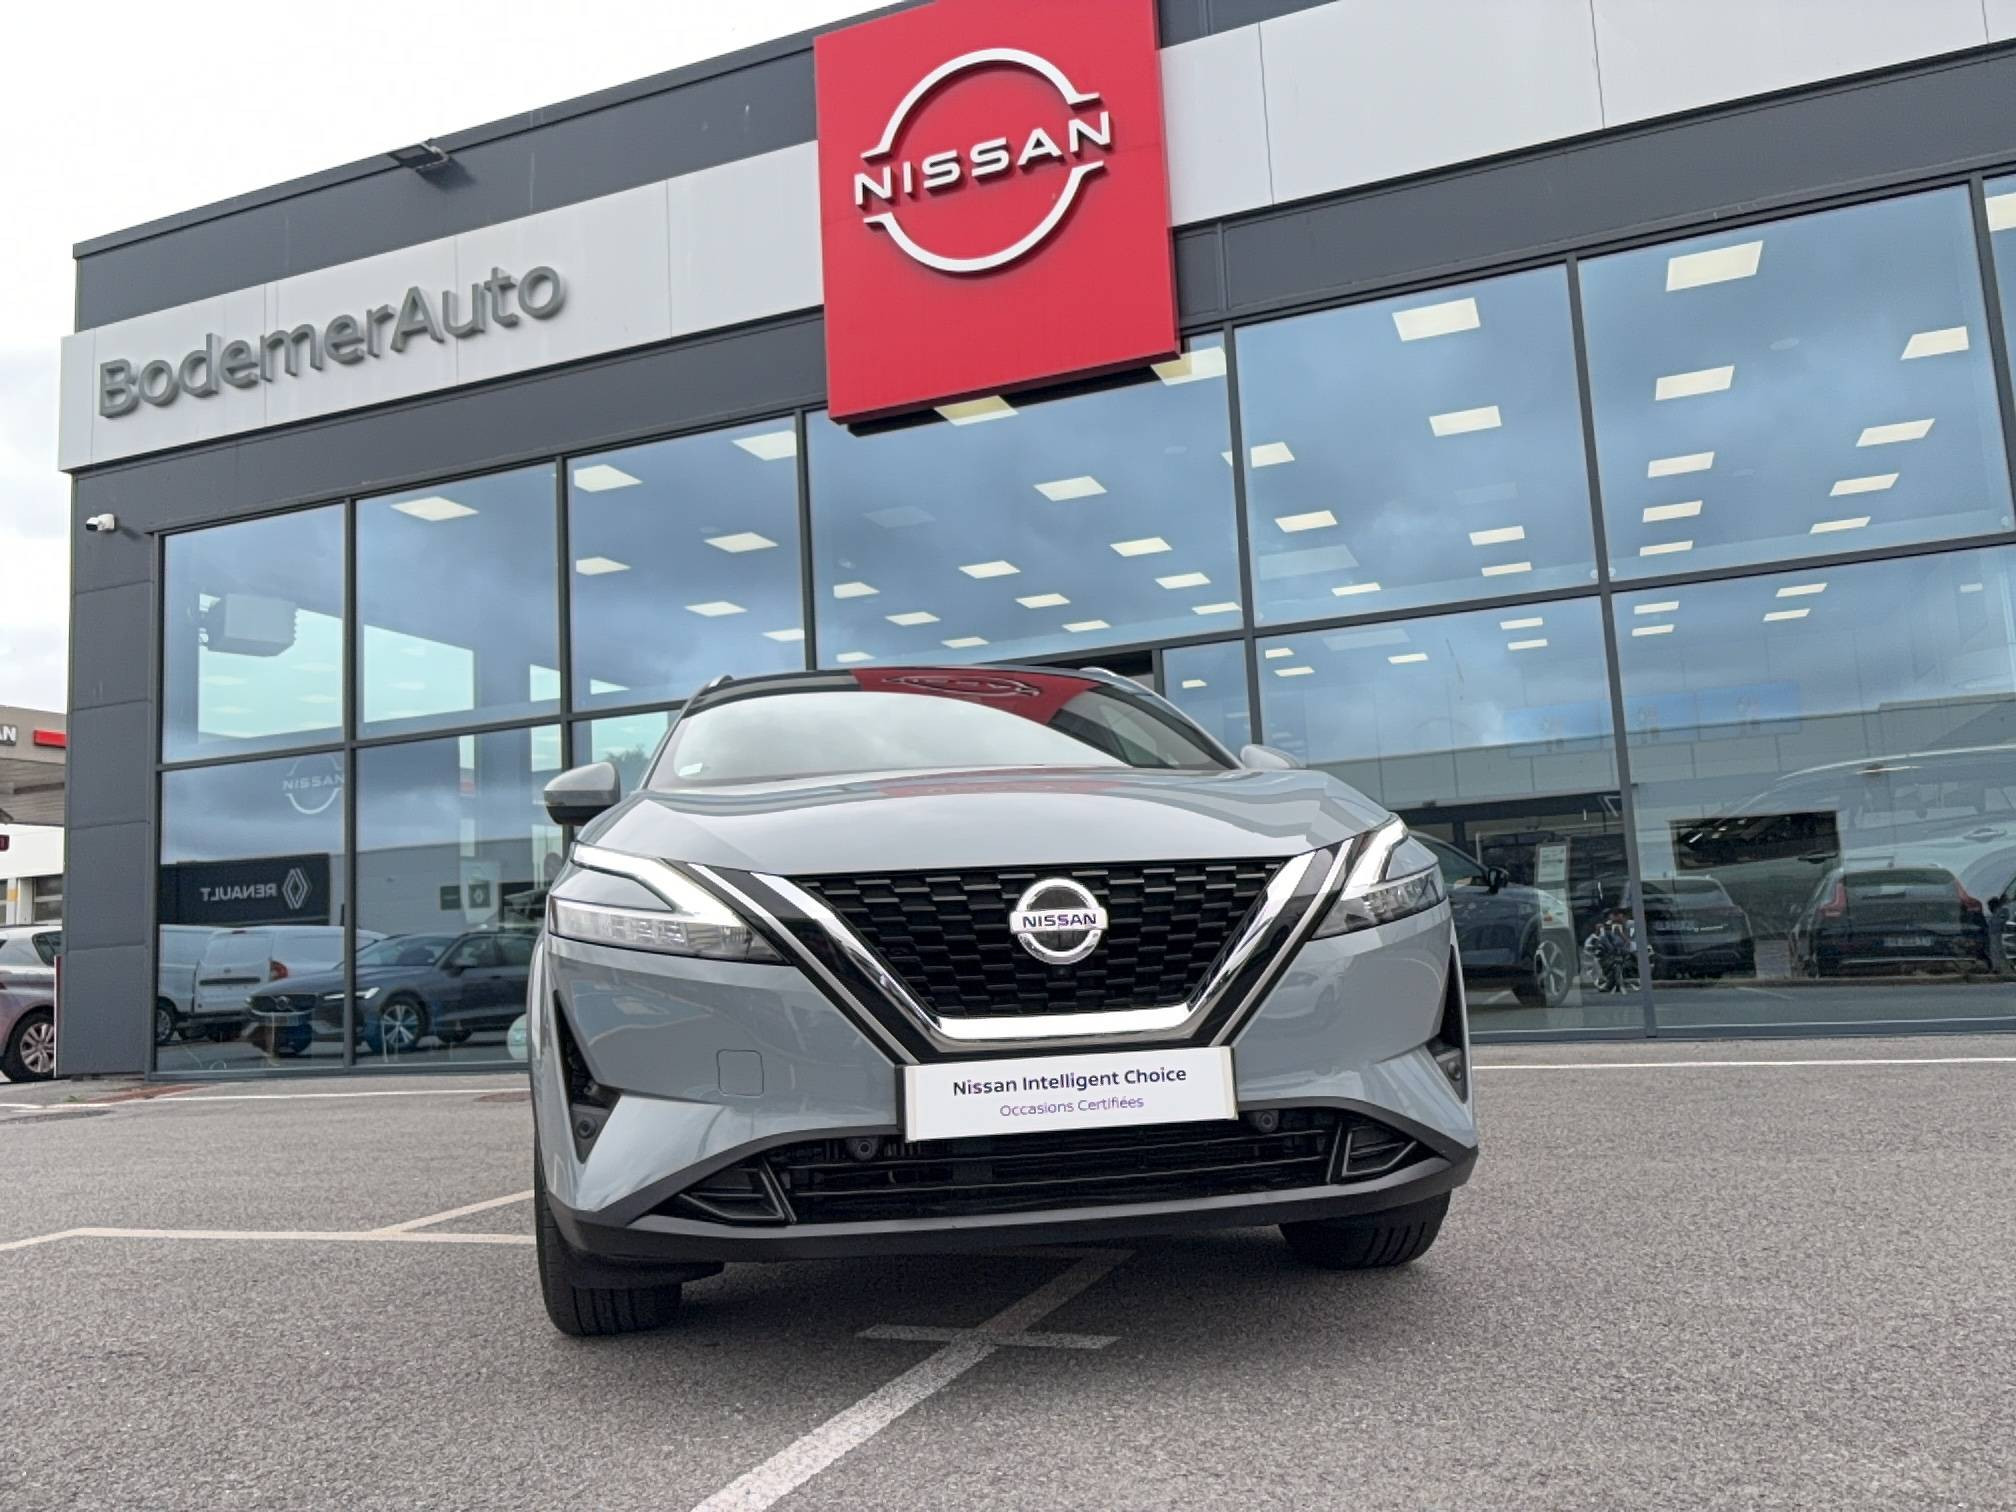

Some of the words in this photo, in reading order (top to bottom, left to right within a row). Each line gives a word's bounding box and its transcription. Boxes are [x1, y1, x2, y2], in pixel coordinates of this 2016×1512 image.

[854, 111, 1111, 206] NISSAN
[99, 265, 567, 418] BodemerAuto
[0, 725, 17, 743] N
[1022, 913, 1097, 929] NISSAN
[953, 1079, 1018, 1097] Nissan
[1022, 1071, 1120, 1092] Intelligent
[1124, 1067, 1188, 1085] Choice
[999, 1101, 1075, 1117] Occasions
[1077, 1096, 1145, 1112] Certifiées
